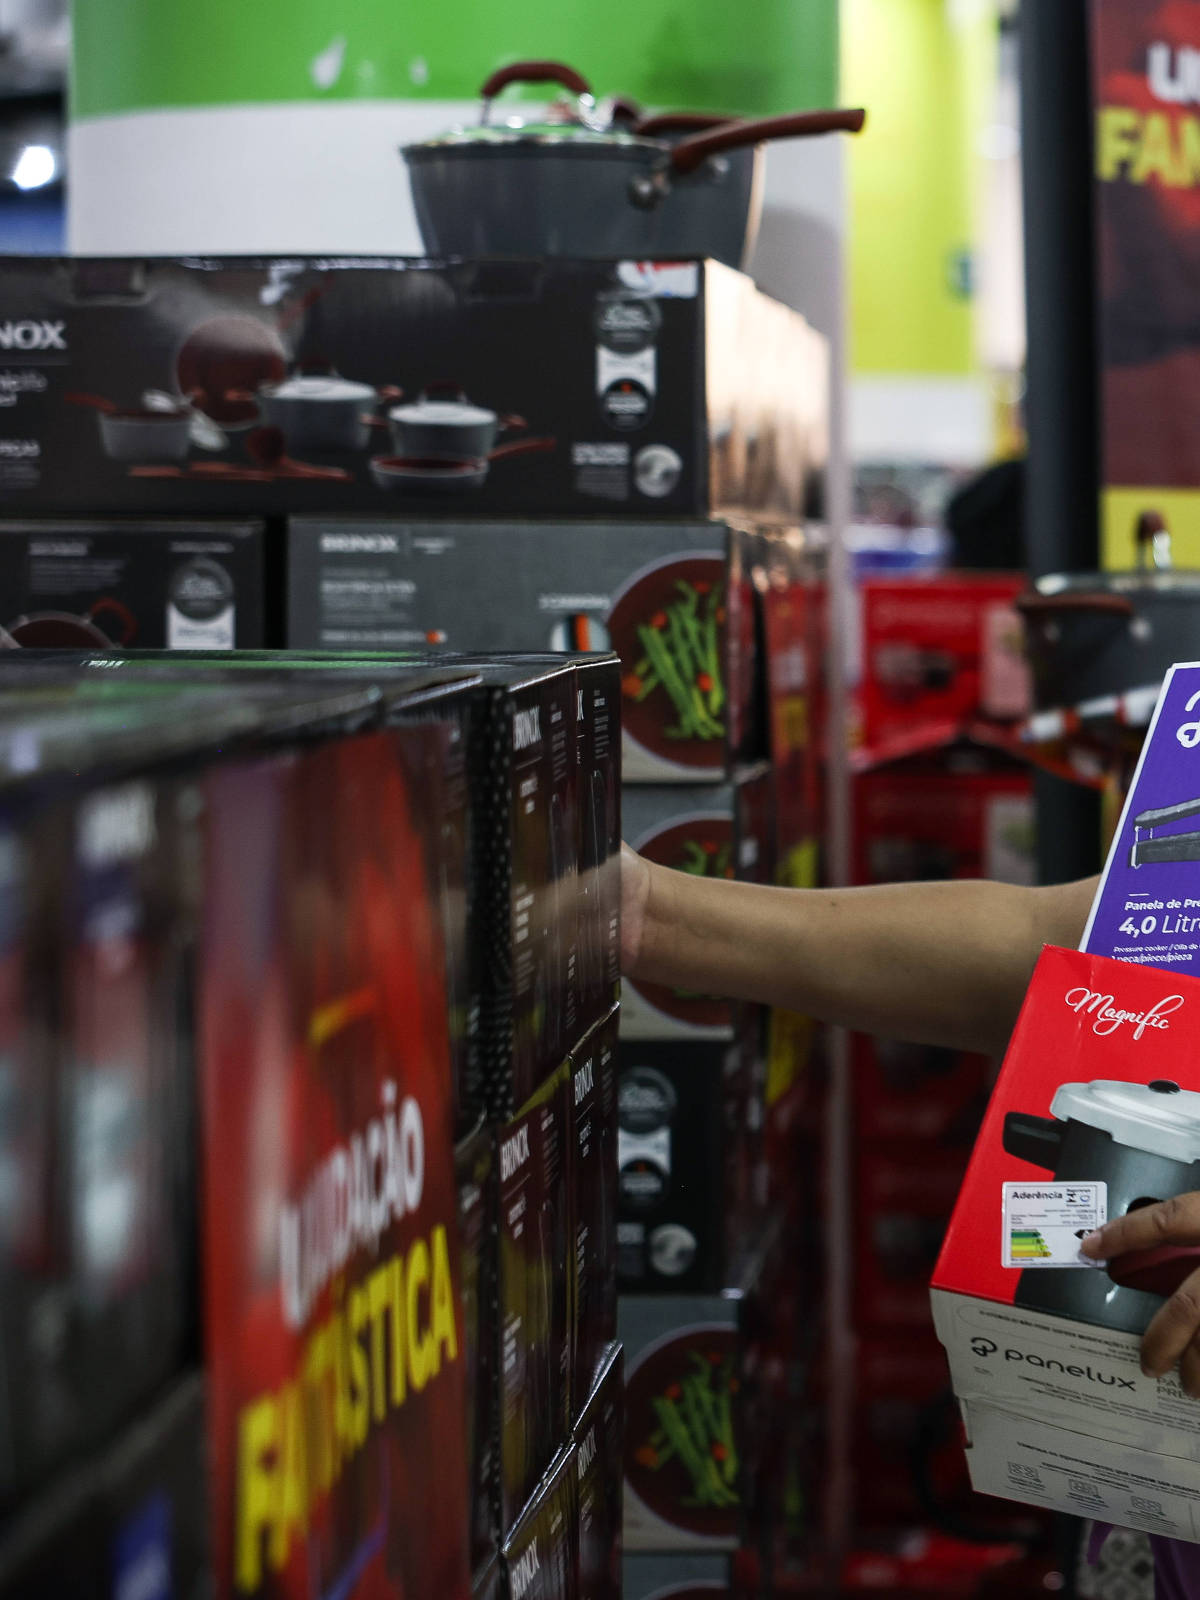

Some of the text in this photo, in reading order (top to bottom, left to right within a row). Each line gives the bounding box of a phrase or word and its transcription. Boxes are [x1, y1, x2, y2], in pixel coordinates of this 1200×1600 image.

[0, 320, 67, 349] NOX
[1124, 900, 1164, 911] Panela
[1166, 899, 1181, 909] de
[1118, 915, 1157, 938] 4,0
[1064, 987, 1185, 1040] Magnific
[1012, 1191, 1063, 1200] Aderência
[1004, 1349, 1136, 1392] panelux
